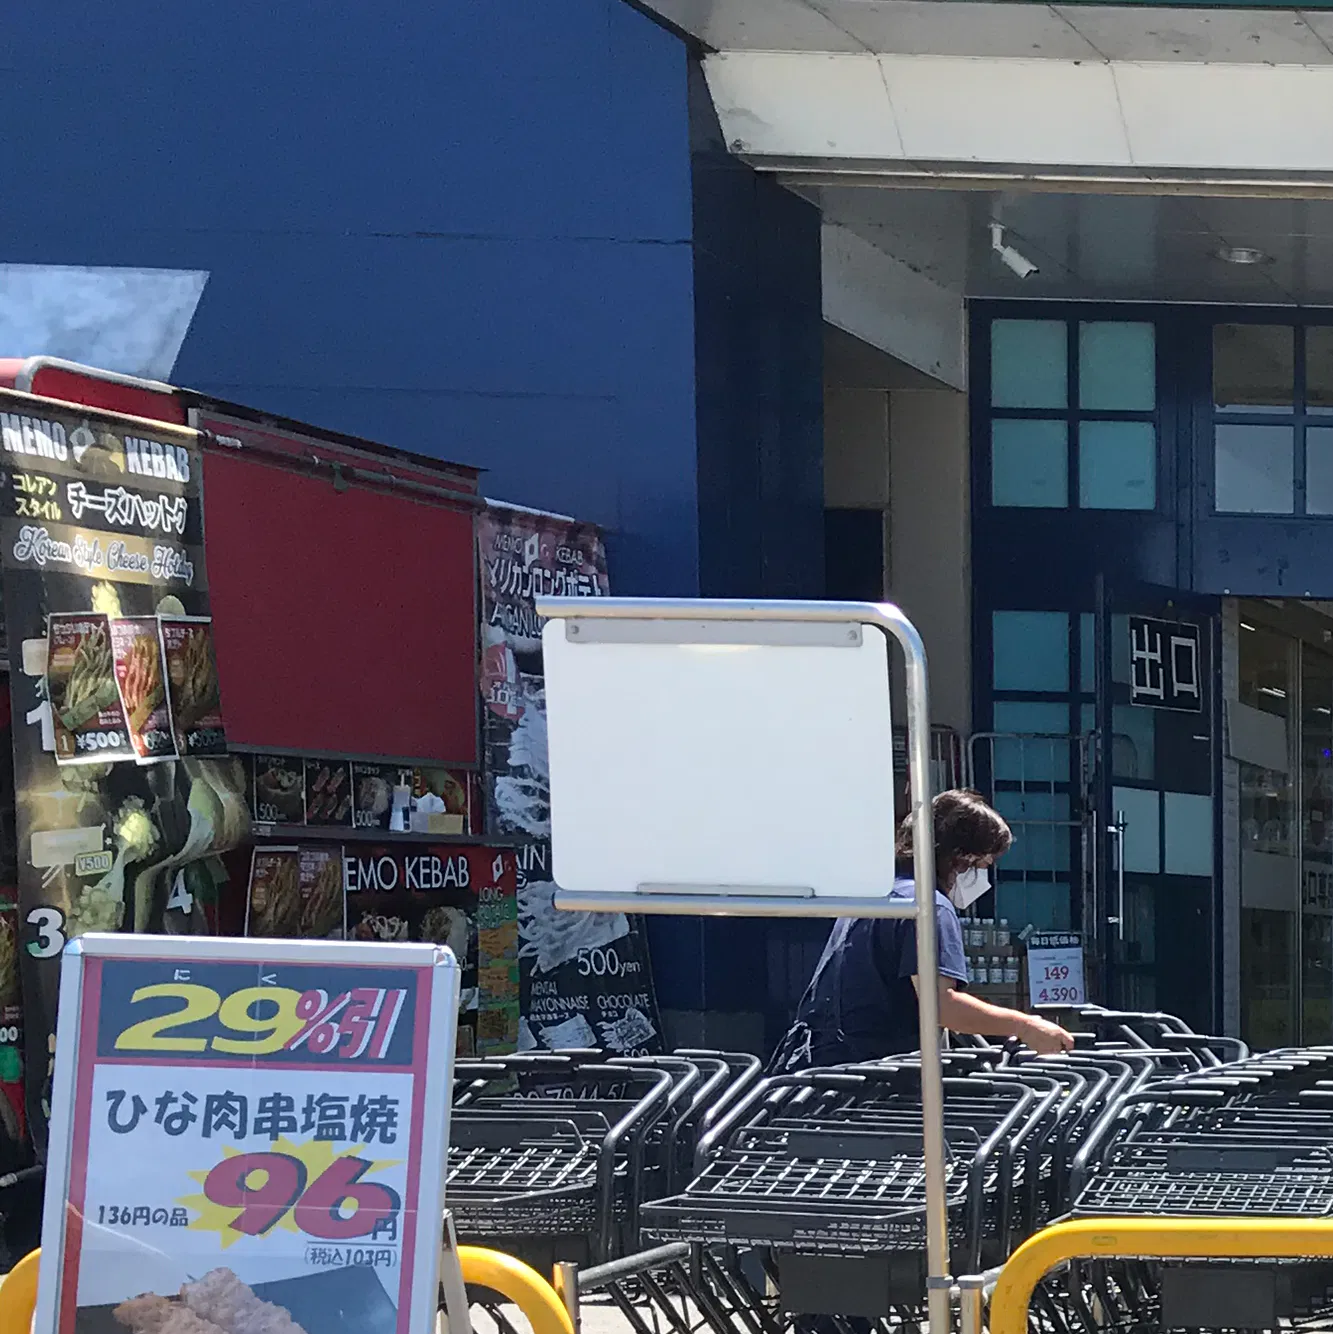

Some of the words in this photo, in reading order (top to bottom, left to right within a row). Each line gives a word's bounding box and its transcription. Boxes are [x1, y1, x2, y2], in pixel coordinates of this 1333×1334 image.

[0, 412, 68, 463] MEMO
[124, 435, 191, 484] KEBAB
[12, 473, 57, 497] コレアン
[15, 497, 62, 521] スタイル
[13, 525, 73, 566] Korean
[73, 535, 104, 573] Style
[106, 540, 149, 573] Cheese
[1131, 623, 1199, 700] 出口
[345, 855, 398, 892] EMO
[404, 855, 470, 891] KEBAB
[26, 908, 65, 958] 3
[174, 968, 192, 982] に
[260, 972, 278, 985] く
[577, 947, 641, 978] 500yen
[1043, 965, 1070, 981] 149
[596, 993, 652, 1010] CHOCOLATE
[0, 1026, 19, 1043] 00
[113, 982, 408, 1060] 29%引
[105, 1088, 400, 1145] ひな肉串塩焼
[97, 1204, 189, 1228] 136円の品
